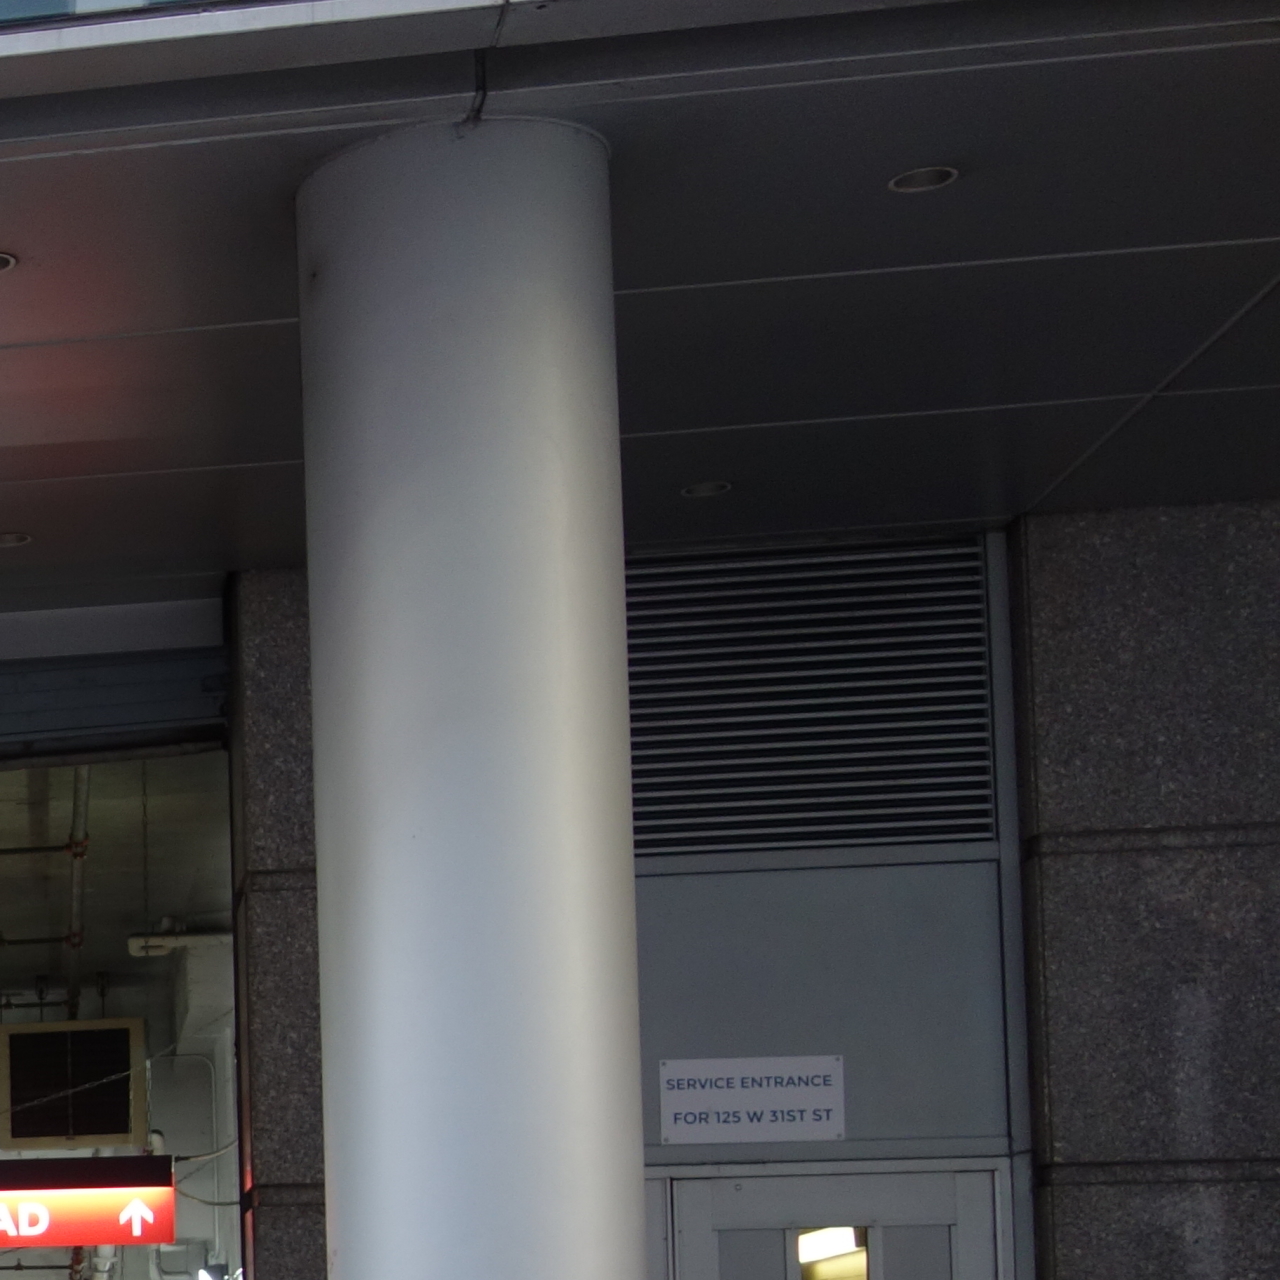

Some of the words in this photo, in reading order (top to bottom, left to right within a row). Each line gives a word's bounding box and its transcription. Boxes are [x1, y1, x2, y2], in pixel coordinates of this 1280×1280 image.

[666, 1077, 735, 1091] SERVICE
[740, 1075, 832, 1089] ENTRANCE
[673, 1112, 709, 1125] FOR
[714, 1111, 741, 1124] 125
[746, 1110, 764, 1123] W
[769, 1109, 807, 1122] 31ST
[812, 1108, 833, 1121] ST
